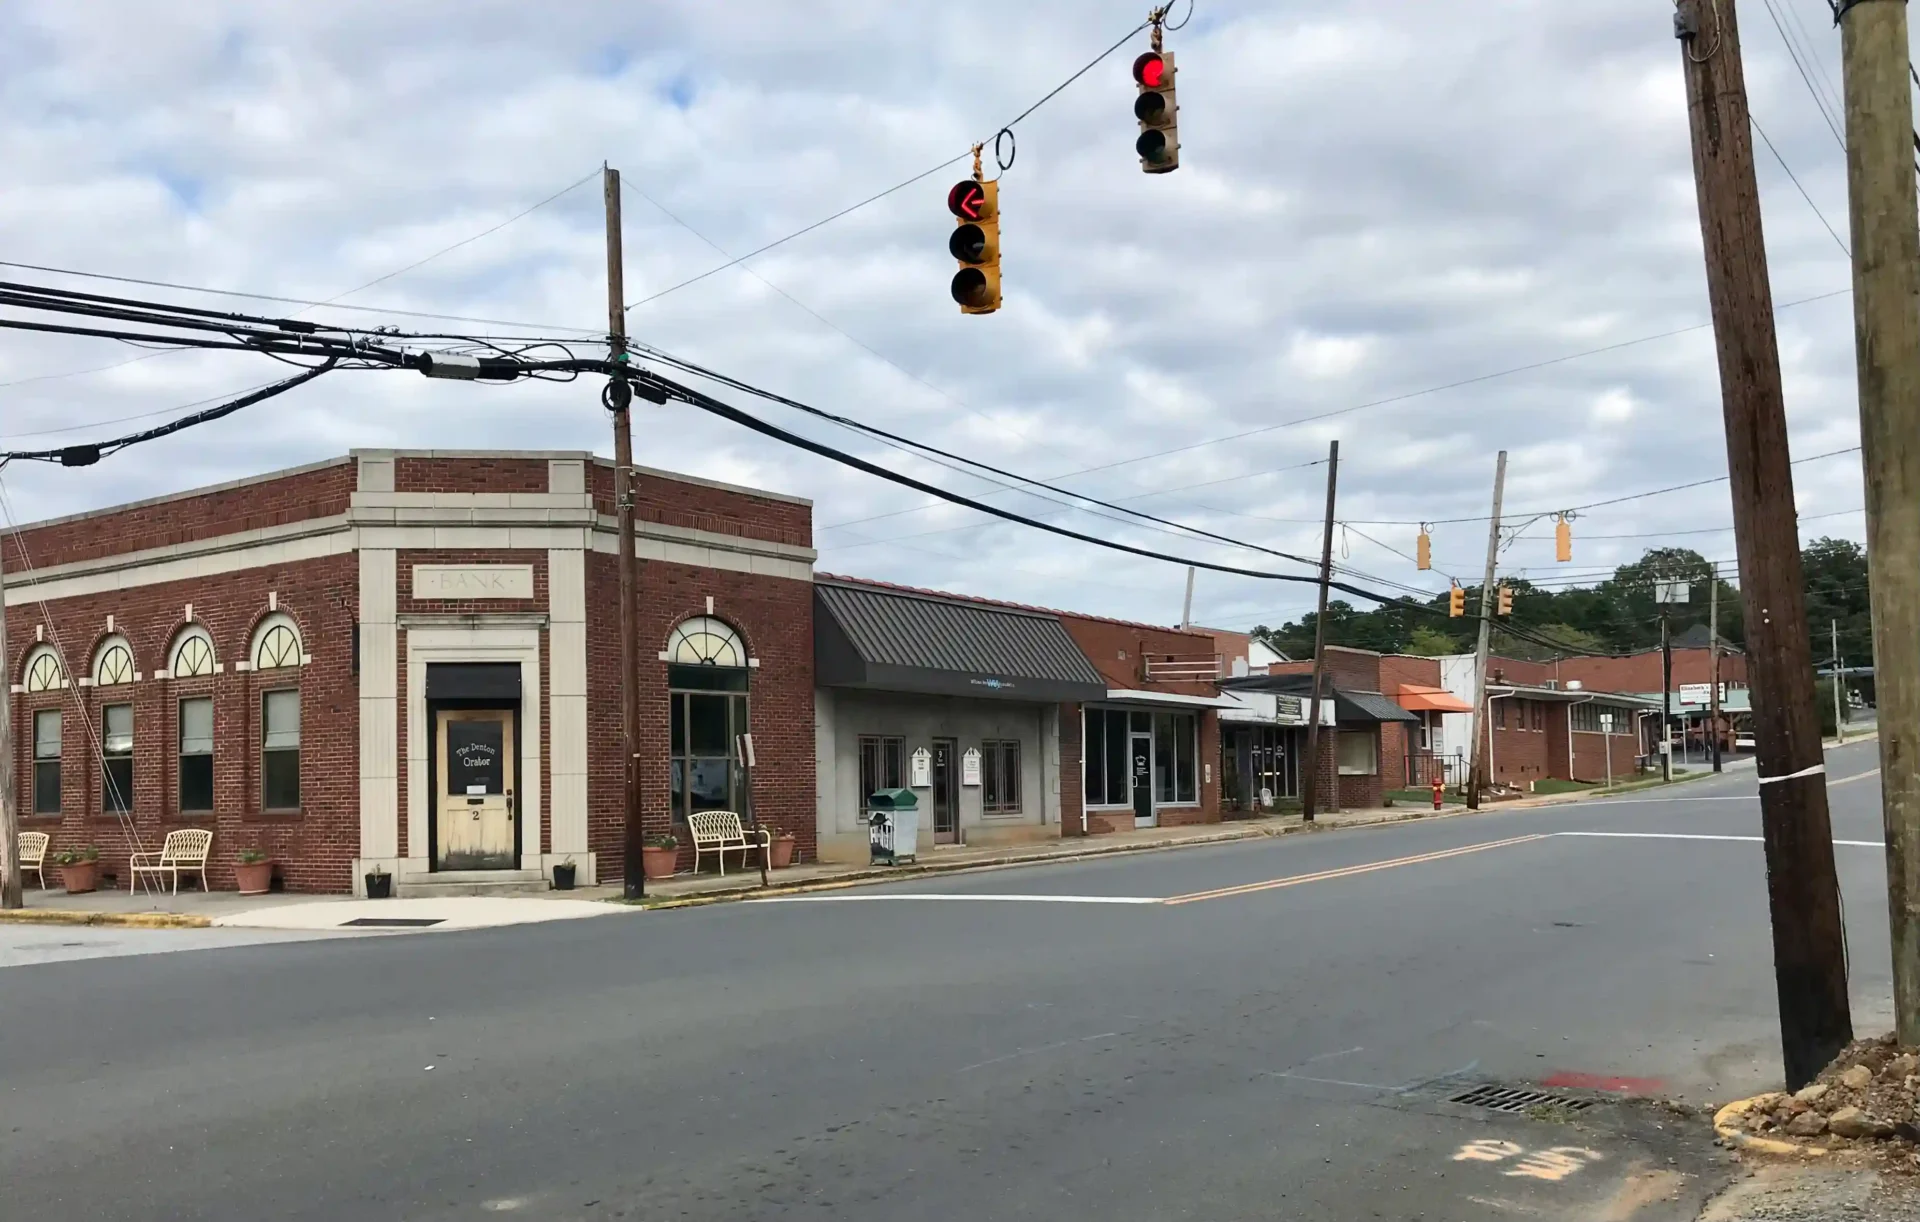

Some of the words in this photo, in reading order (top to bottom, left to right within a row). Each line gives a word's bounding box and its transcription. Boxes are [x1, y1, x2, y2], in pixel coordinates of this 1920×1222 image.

[440, 572, 505, 590] BANK
[455, 746, 470, 757] The
[471, 742, 496, 755] Denton
[463, 756, 491, 767] Orator
[472, 810, 480, 820] 2
